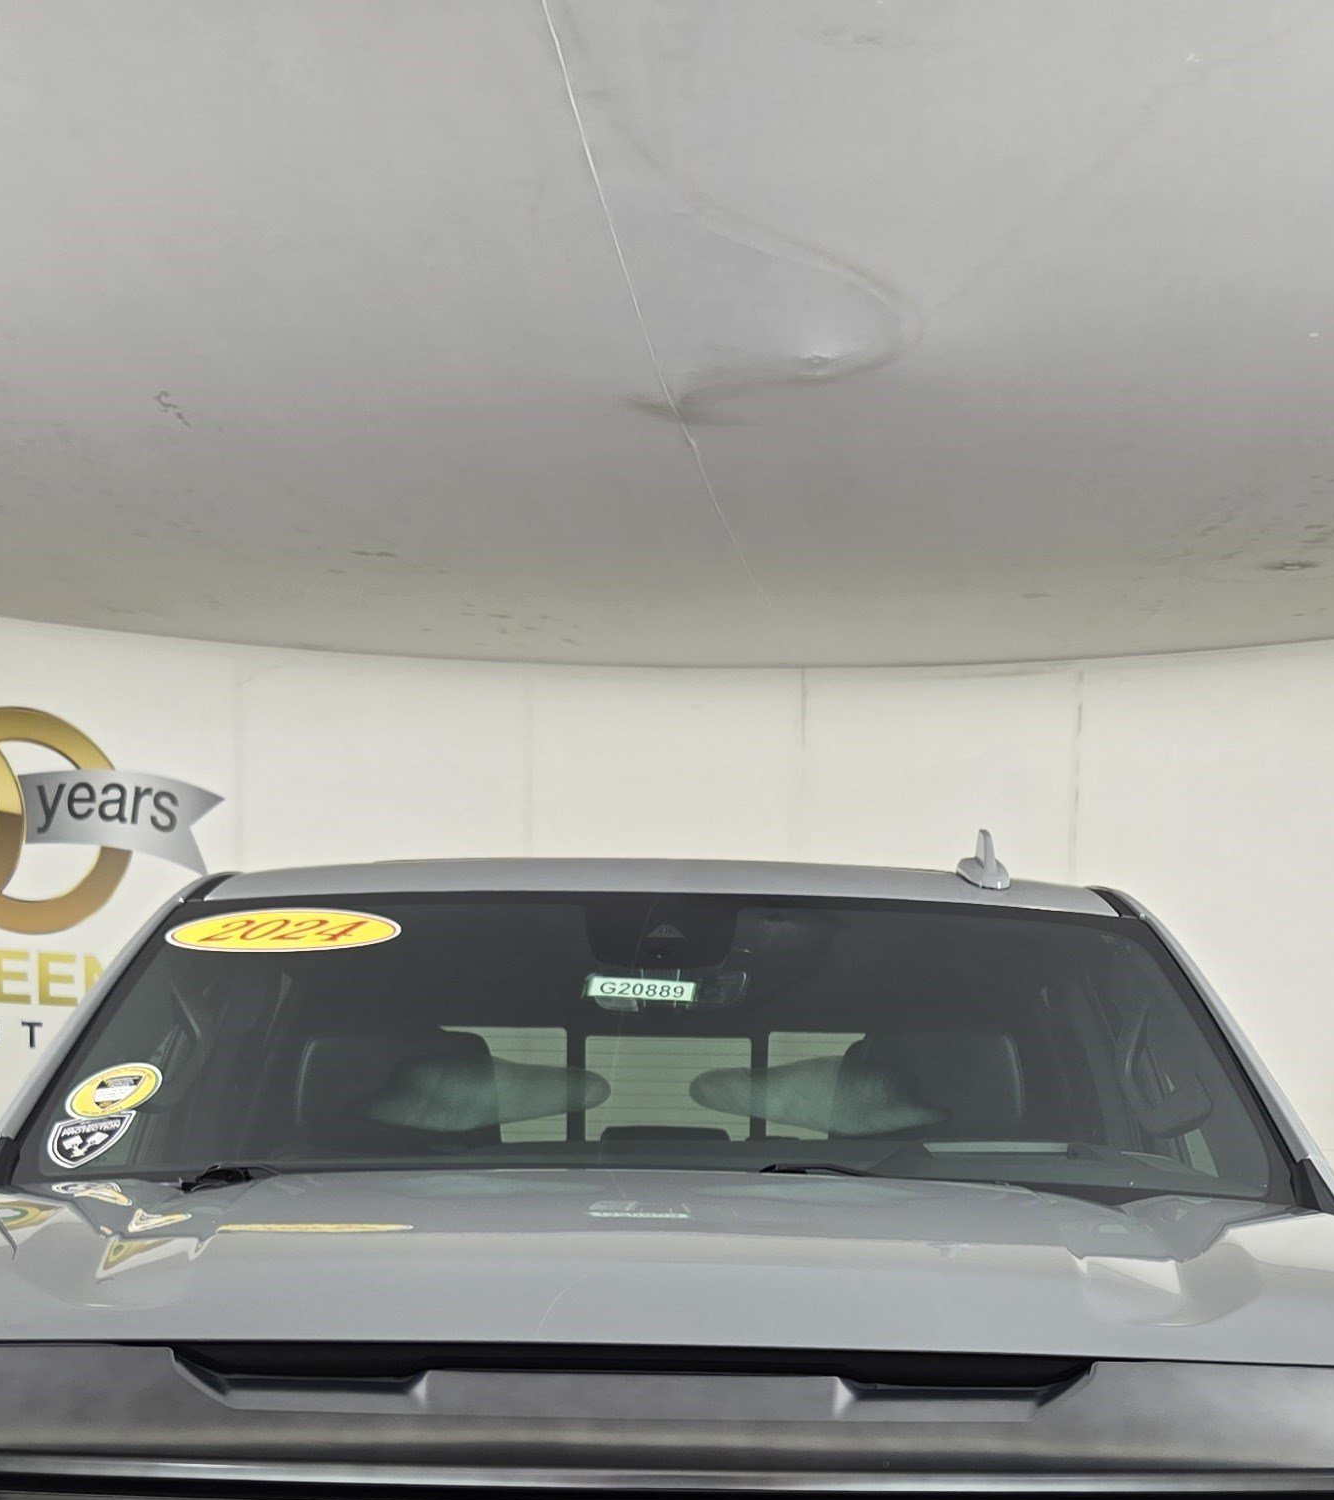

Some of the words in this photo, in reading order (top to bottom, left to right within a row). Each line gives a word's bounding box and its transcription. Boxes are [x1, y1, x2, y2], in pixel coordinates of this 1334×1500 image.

[34, 779, 180, 835] years
[198, 919, 369, 942] 2024
[600, 982, 685, 998] G20889
